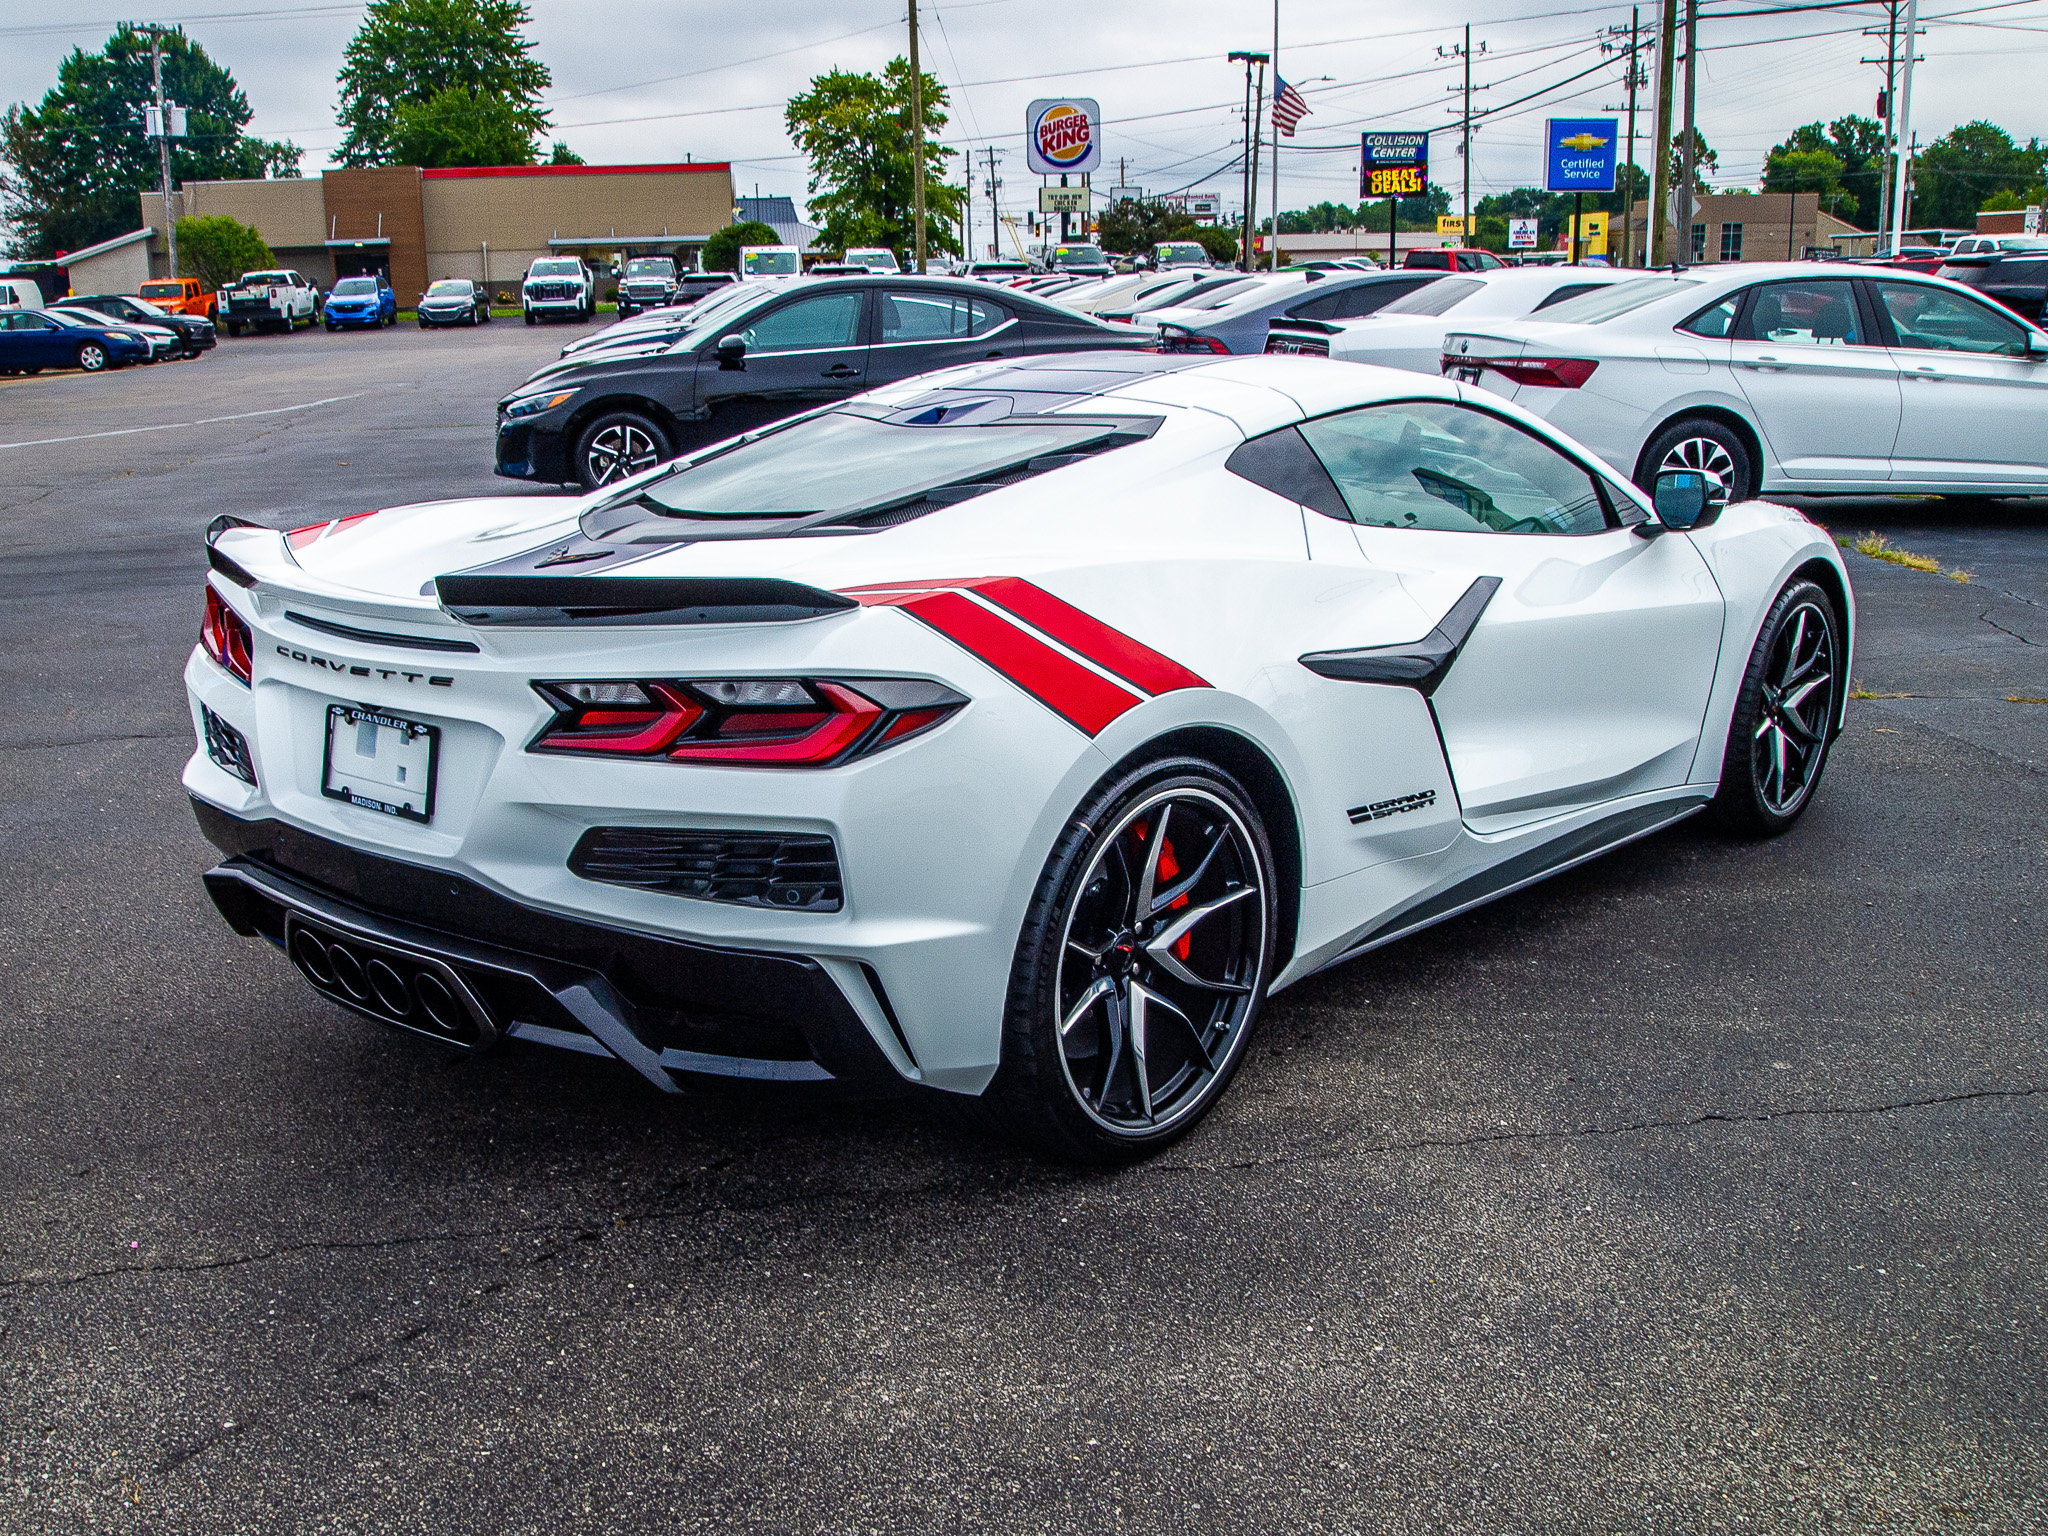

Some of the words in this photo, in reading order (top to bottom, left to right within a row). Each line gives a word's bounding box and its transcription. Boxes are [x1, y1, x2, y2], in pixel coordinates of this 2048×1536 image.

[1040, 114, 1088, 139] BURGER
[1042, 125, 1090, 155] KING
[1366, 134, 1425, 146] COLLISION
[1372, 147, 1416, 158] CENTER
[1561, 158, 1605, 169] Certified
[1371, 168, 1418, 181] GREAT
[1564, 169, 1600, 179] Service
[1371, 178, 1422, 195] DEALS!
[276, 645, 454, 687] CORVETTE
[351, 710, 409, 730] CHANDLER
[383, 803, 398, 815] IND.
[1368, 789, 1437, 812] GRAND
[1372, 796, 1438, 820] SPORT
